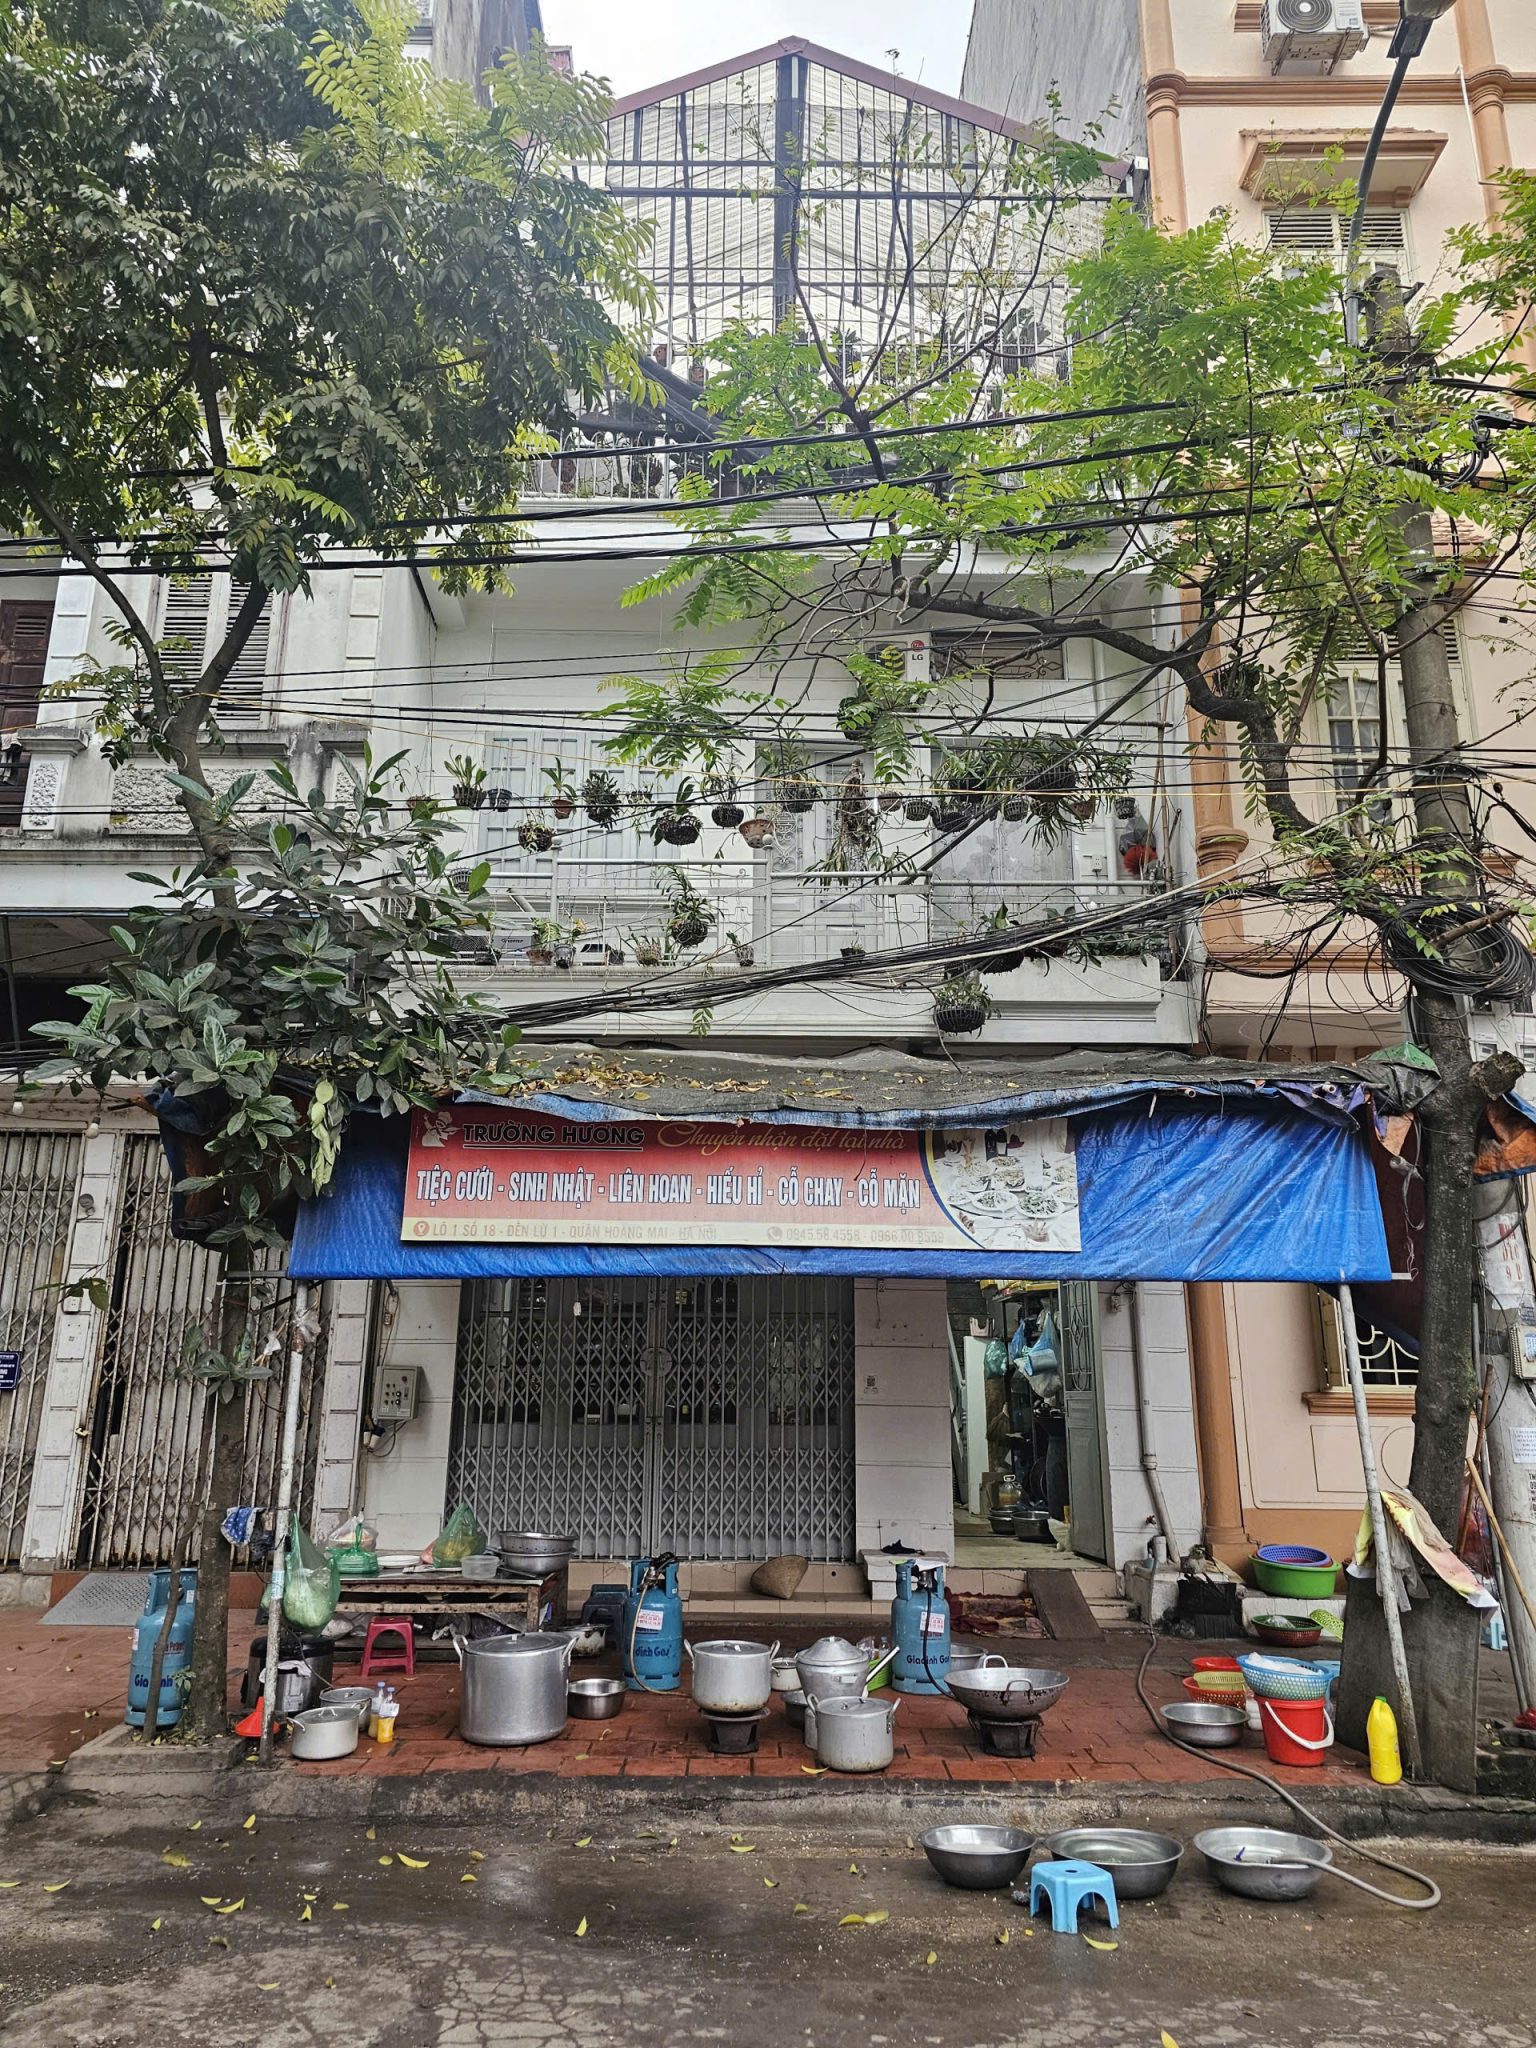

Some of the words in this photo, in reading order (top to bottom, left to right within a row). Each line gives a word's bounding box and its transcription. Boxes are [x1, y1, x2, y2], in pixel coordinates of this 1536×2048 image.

[911, 653, 924, 661] LG
[462, 1119, 555, 1144] TRƯỜNG
[562, 1123, 645, 1145] HƯƠNG
[657, 1121, 744, 1156] Chuyên
[748, 1127, 797, 1151] nhận
[800, 1128, 836, 1151] đặt
[838, 1130, 866, 1152] tại
[867, 1130, 907, 1150] nhà
[416, 1164, 452, 1207] TIỆC
[455, 1165, 494, 1201] CƯỚI
[508, 1172, 548, 1202] SINH
[551, 1166, 596, 1209] NHẬT
[608, 1167, 645, 1203] LIÊN
[648, 1174, 692, 1205] HOAN
[706, 1166, 743, 1206] HIẾU
[747, 1166, 764, 1206] HỈ
[778, 1166, 799, 1207] CỖ
[803, 1176, 843, 1207] CHAY
[857, 1167, 880, 1208] CỖ
[883, 1172, 921, 1215] MẶN
[432, 1220, 448, 1237] LÔ
[462, 1219, 478, 1238] SỐ
[483, 1224, 497, 1237] 18
[647, 1225, 669, 1240] MAI
